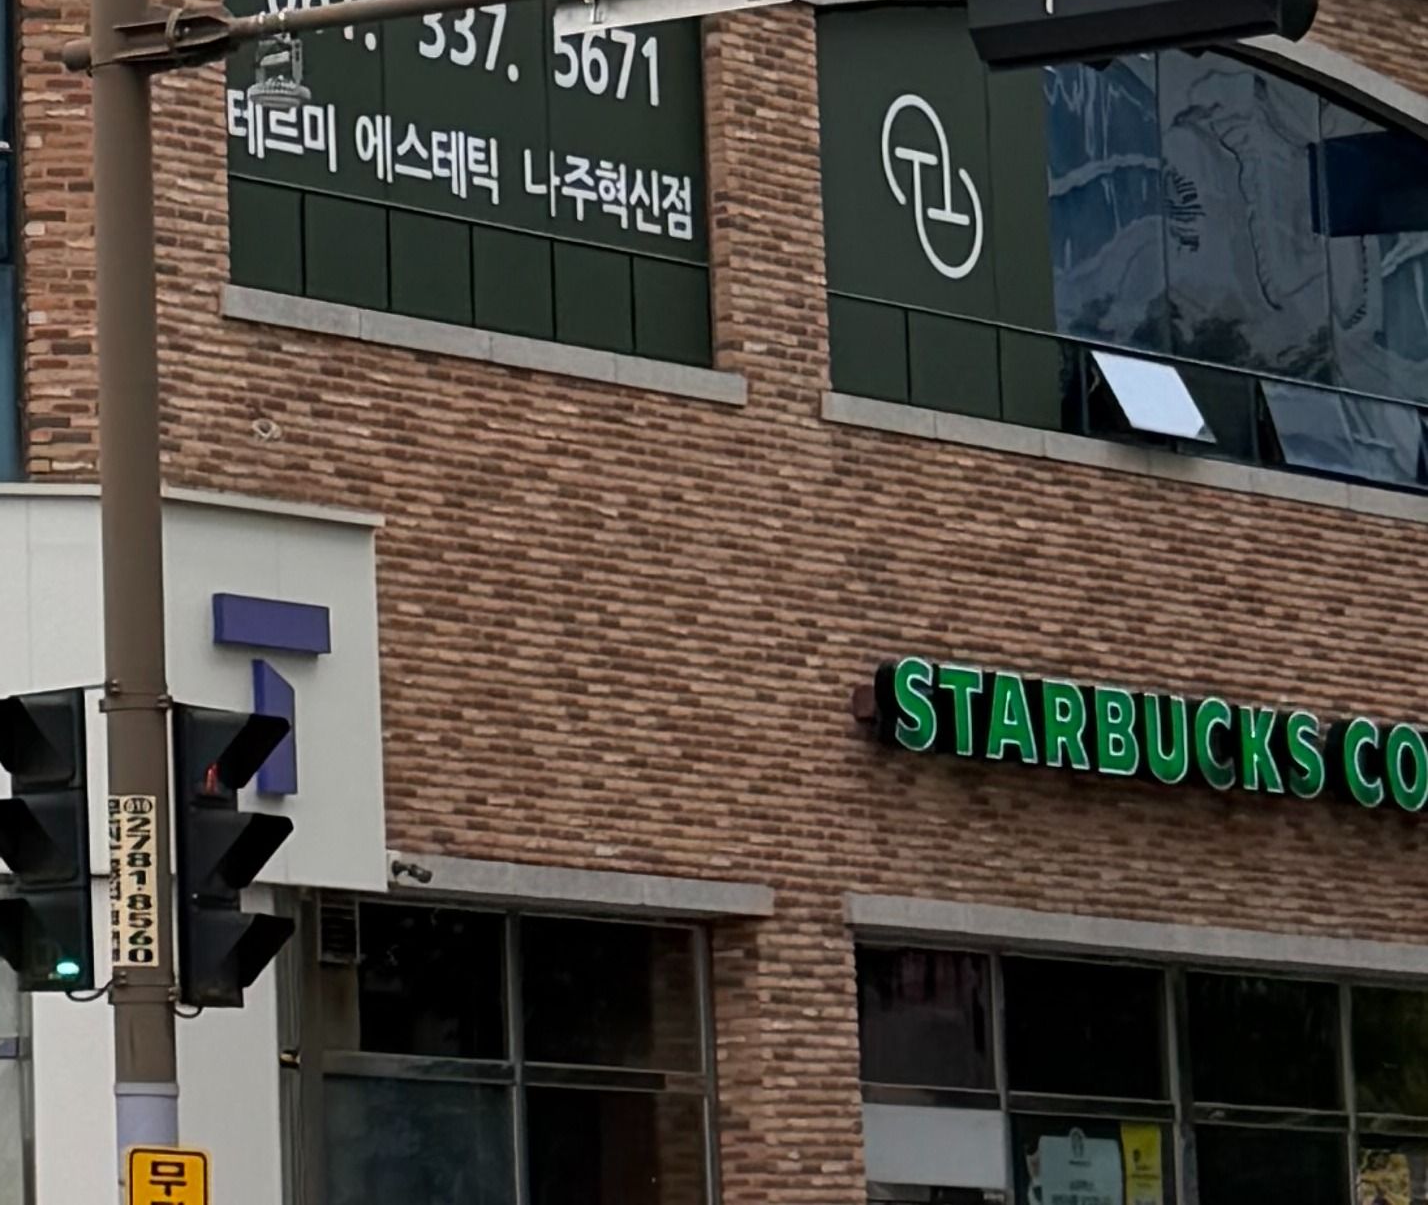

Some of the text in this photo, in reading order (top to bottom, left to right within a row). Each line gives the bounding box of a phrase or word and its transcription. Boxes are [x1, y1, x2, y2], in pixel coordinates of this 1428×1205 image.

[227, 88, 694, 241] 테르미 에스테틱 나주혁신점
[893, 655, 1428, 813] STARBUCKS CO
